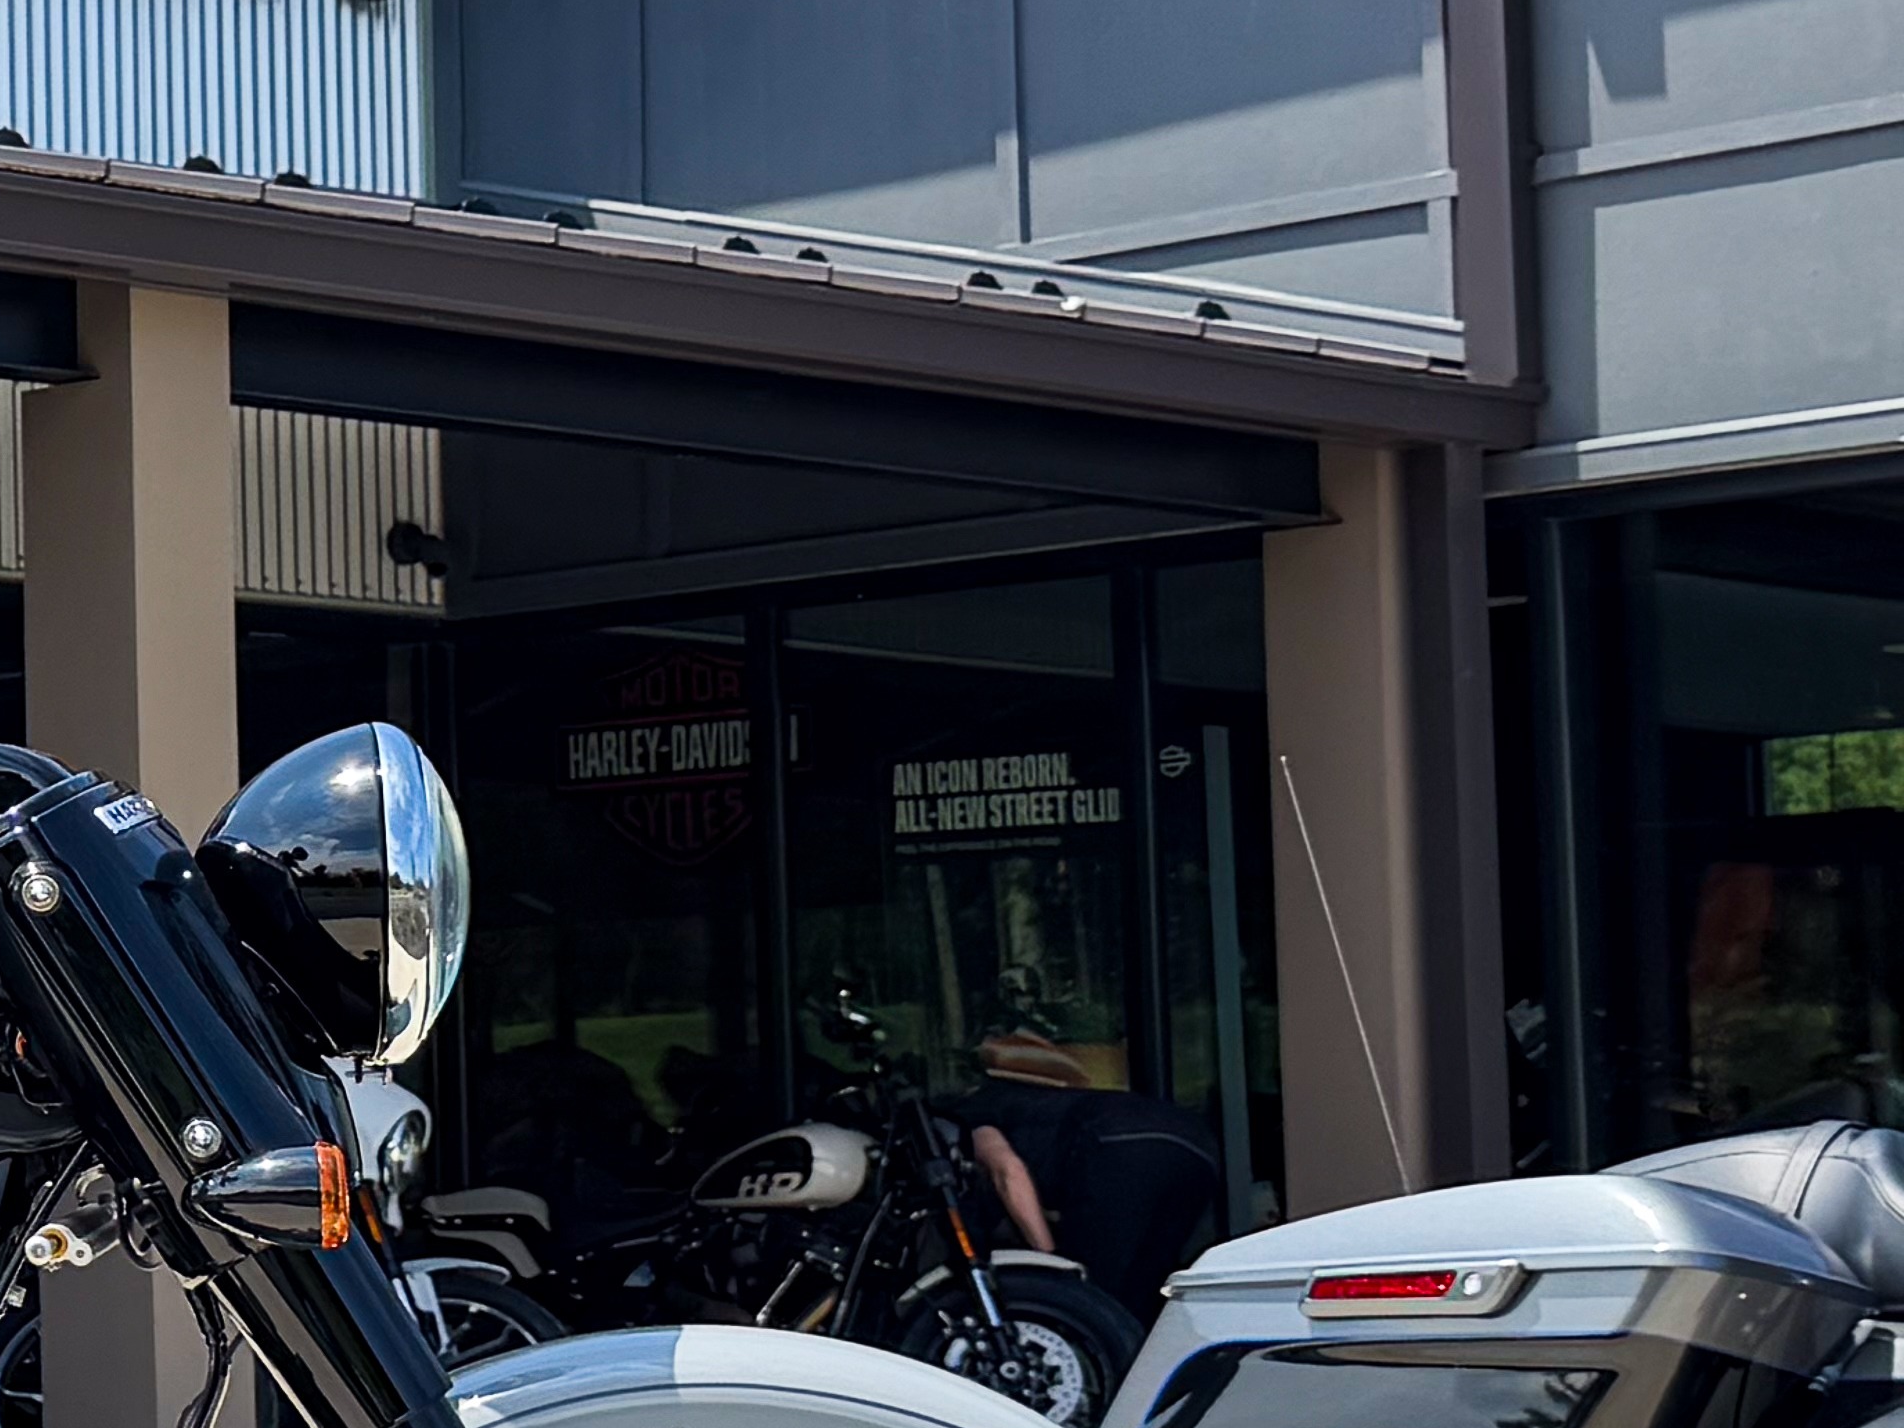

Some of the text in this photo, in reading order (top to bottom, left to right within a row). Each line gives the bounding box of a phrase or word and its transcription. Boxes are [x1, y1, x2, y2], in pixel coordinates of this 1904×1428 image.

[620, 659, 742, 710] MOTOR
[567, 714, 800, 781] HARLEY-DAVID
[892, 762, 922, 796] AN
[926, 758, 979, 794] ICON
[622, 786, 745, 852] CYCLES
[894, 787, 1121, 834] ALL-NEW STREET GLID
